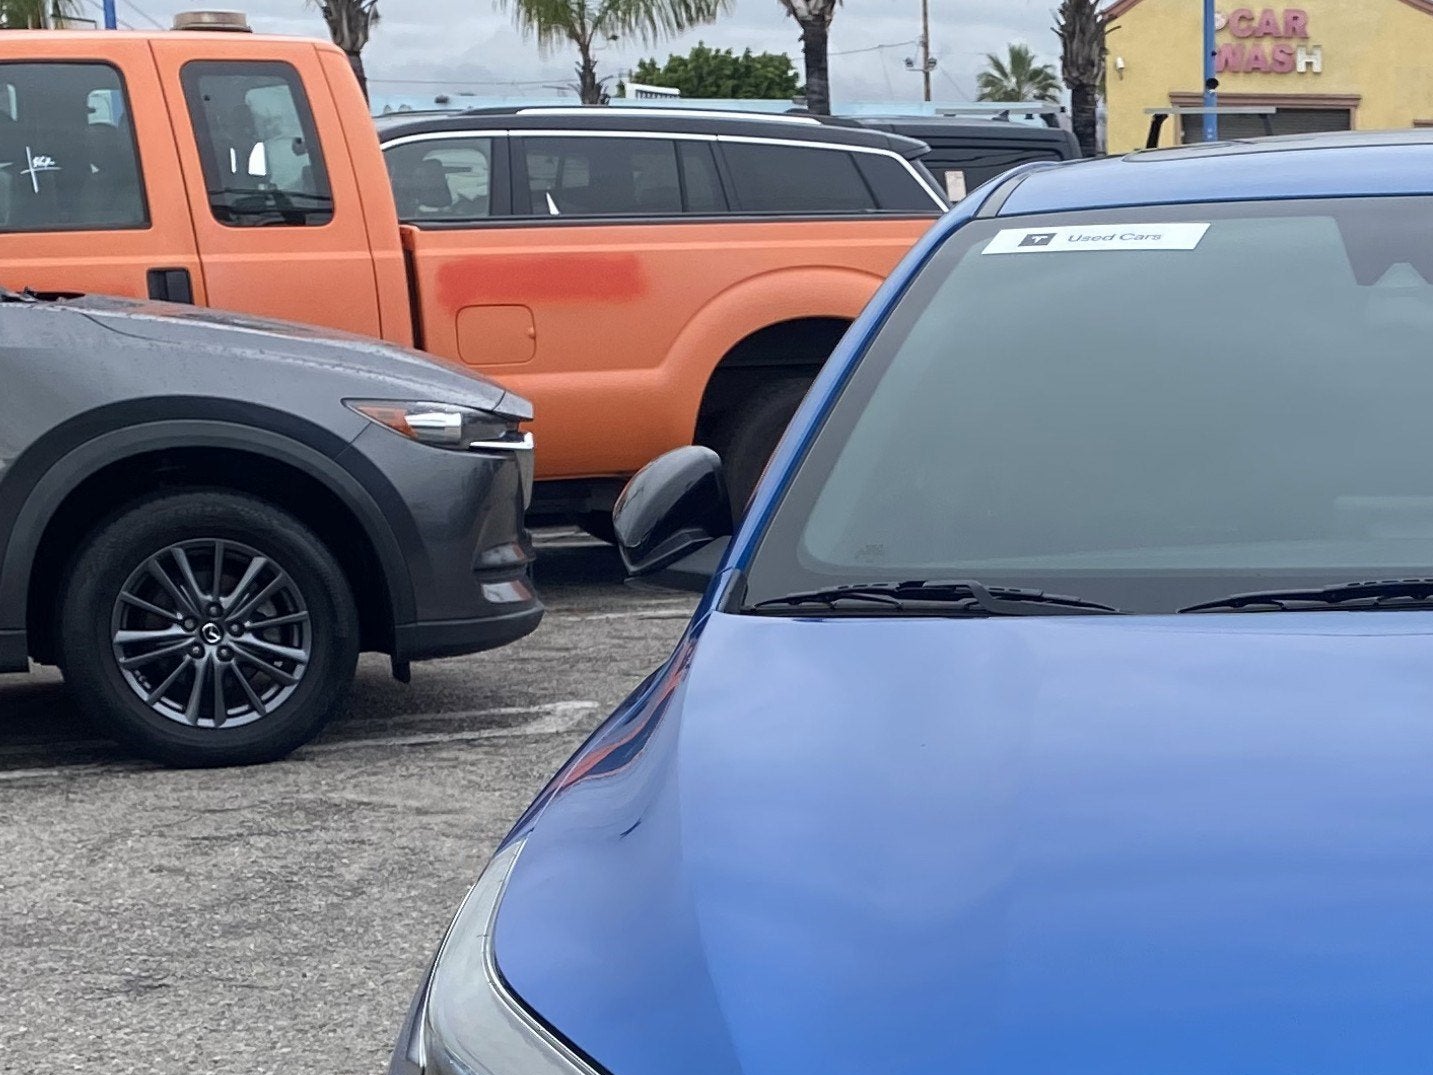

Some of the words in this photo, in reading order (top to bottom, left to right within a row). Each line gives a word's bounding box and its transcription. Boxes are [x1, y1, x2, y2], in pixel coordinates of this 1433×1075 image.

[1228, 8, 1309, 38] CAR
[1067, 233, 1116, 243] Used
[1119, 231, 1162, 241] Cars
